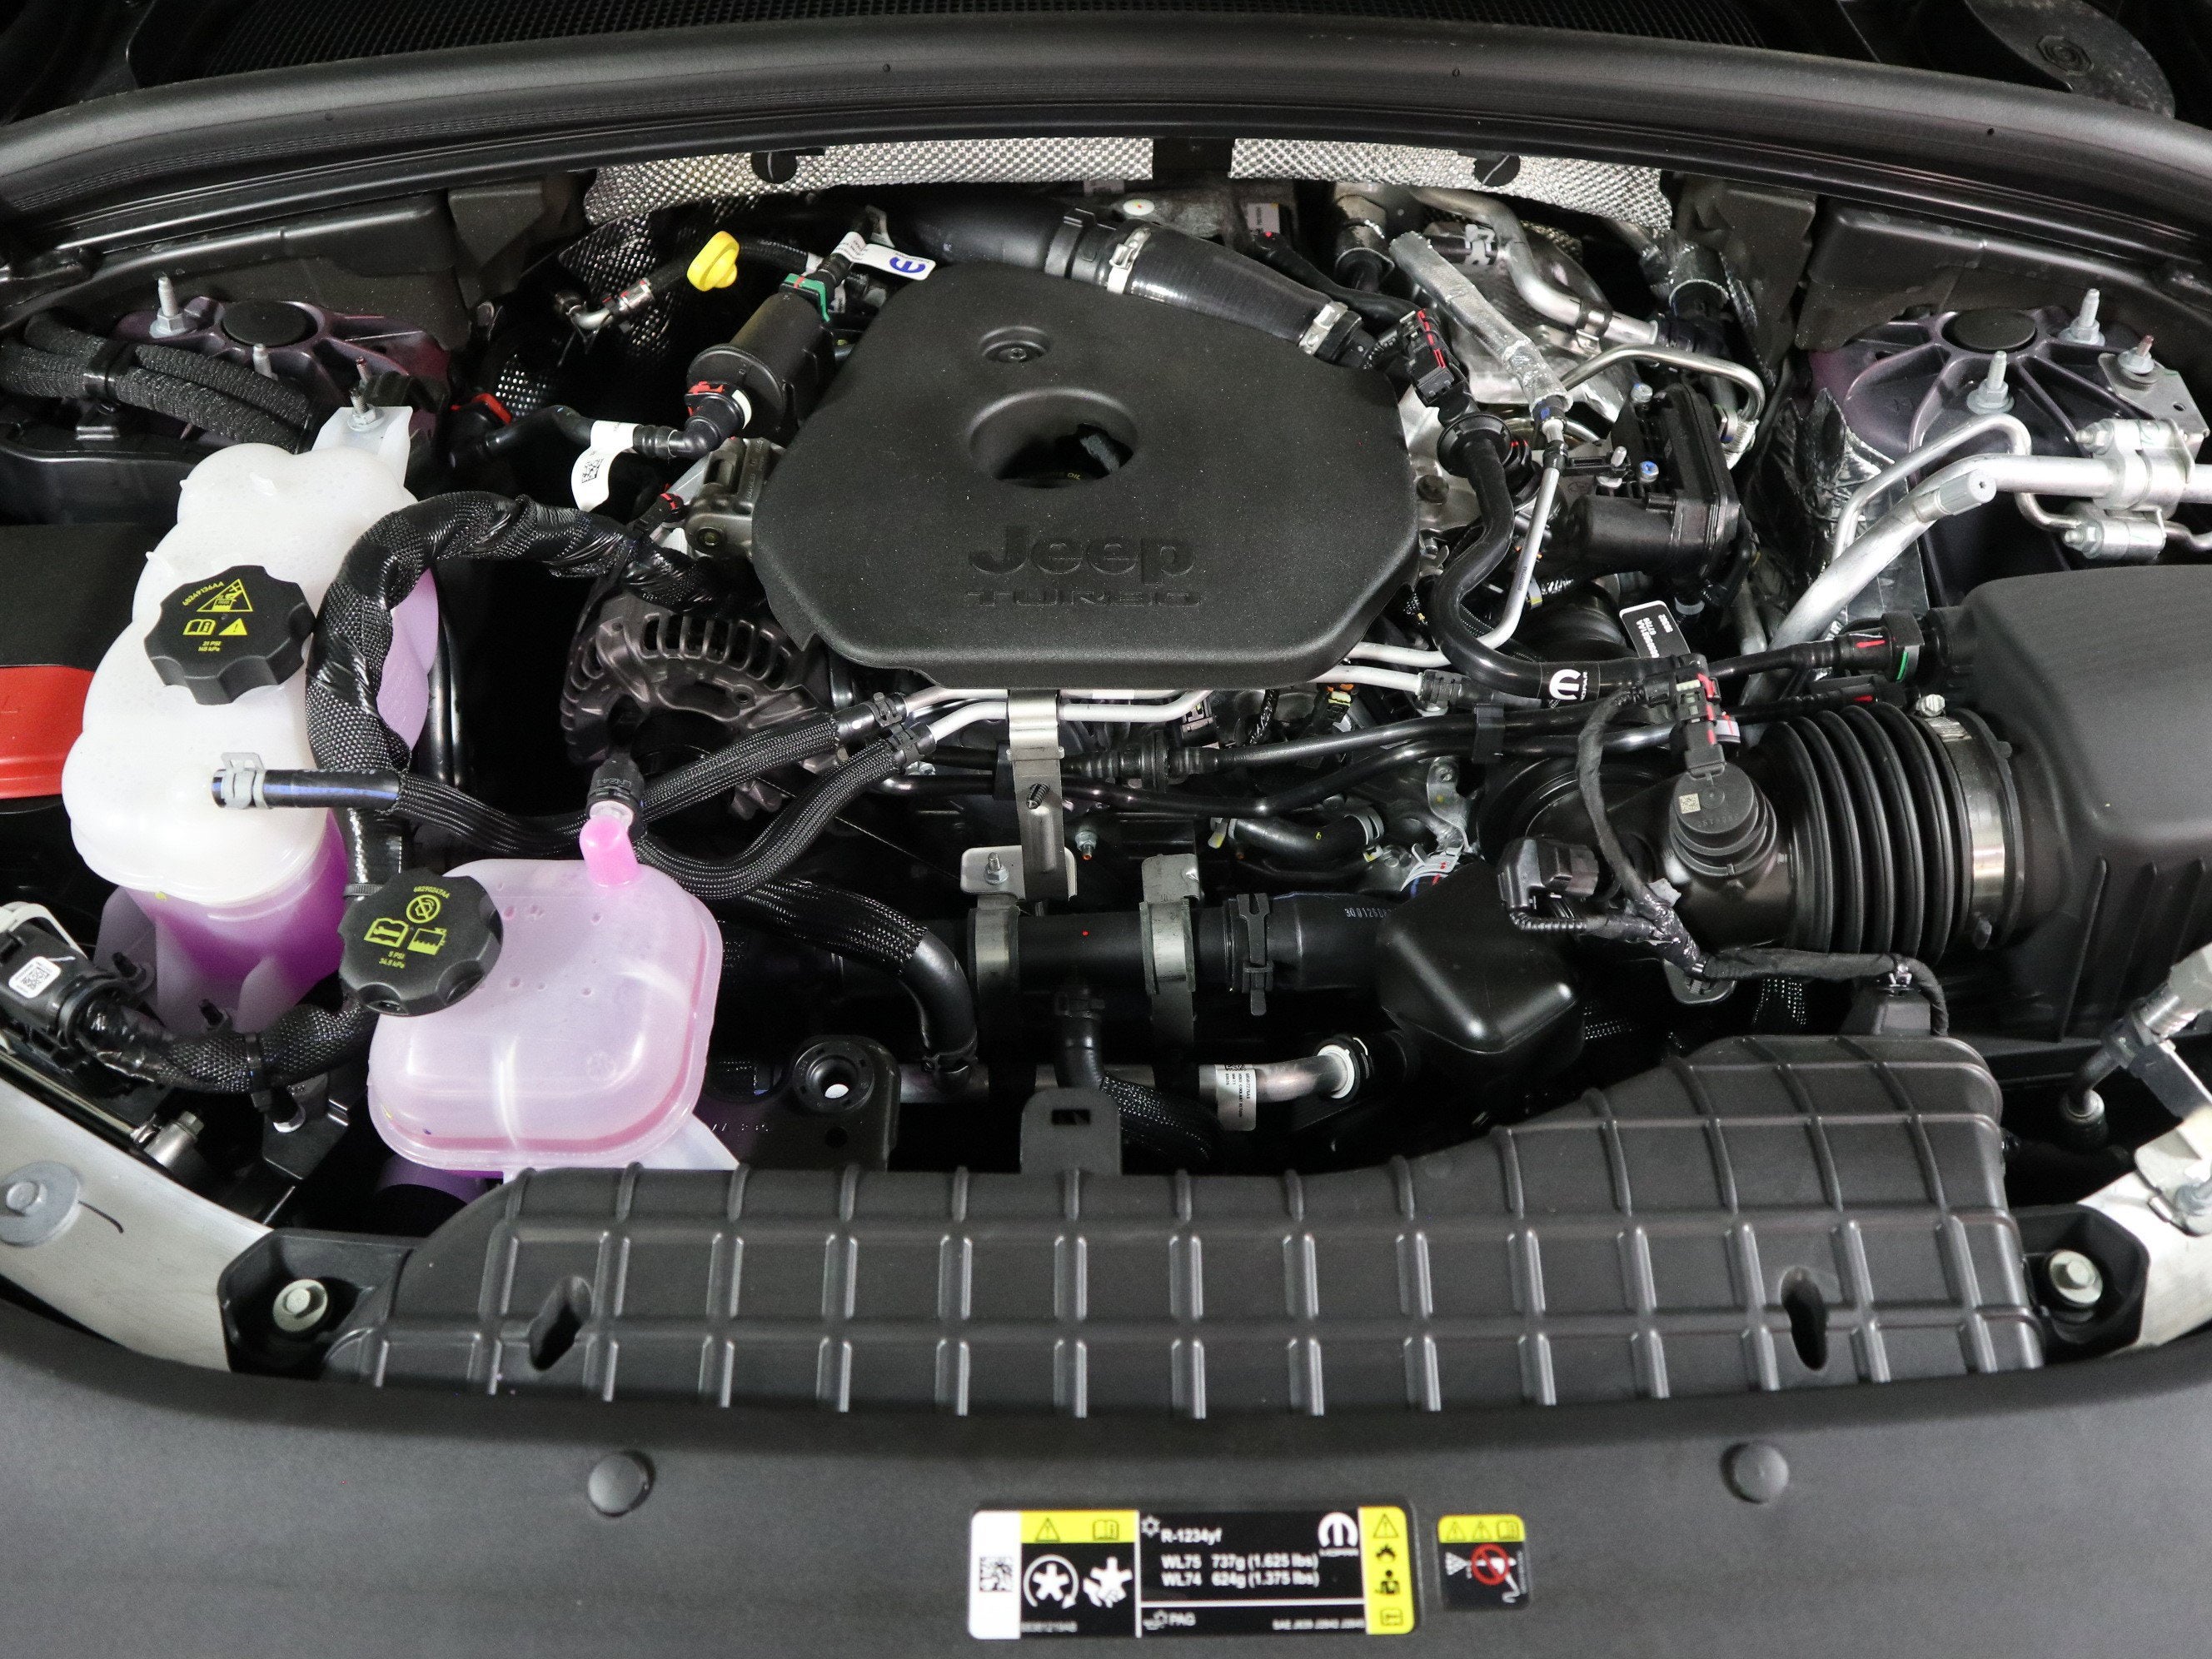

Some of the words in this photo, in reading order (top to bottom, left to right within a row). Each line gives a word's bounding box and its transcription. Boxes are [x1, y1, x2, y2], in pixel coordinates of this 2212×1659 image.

[1067, 472, 1081, 481] OIL
[968, 526, 1196, 585] Jeep
[966, 588, 1202, 606] TURBO
[1579, 670, 1588, 701] MOPAR
[394, 951, 406, 959] PSI
[1161, 1527, 1223, 1546] R-1234yf
[1161, 1553, 1202, 1570] WL75
[1211, 1554, 1246, 1571] 737g
[1292, 1552, 1318, 1570] lbs)
[1161, 1571, 1203, 1587] WL74
[1211, 1571, 1247, 1588] 624g
[1248, 1571, 1291, 1588] (1.375
[1292, 1570, 1320, 1587] lbs)
[1168, 1611, 1197, 1627] PAG
